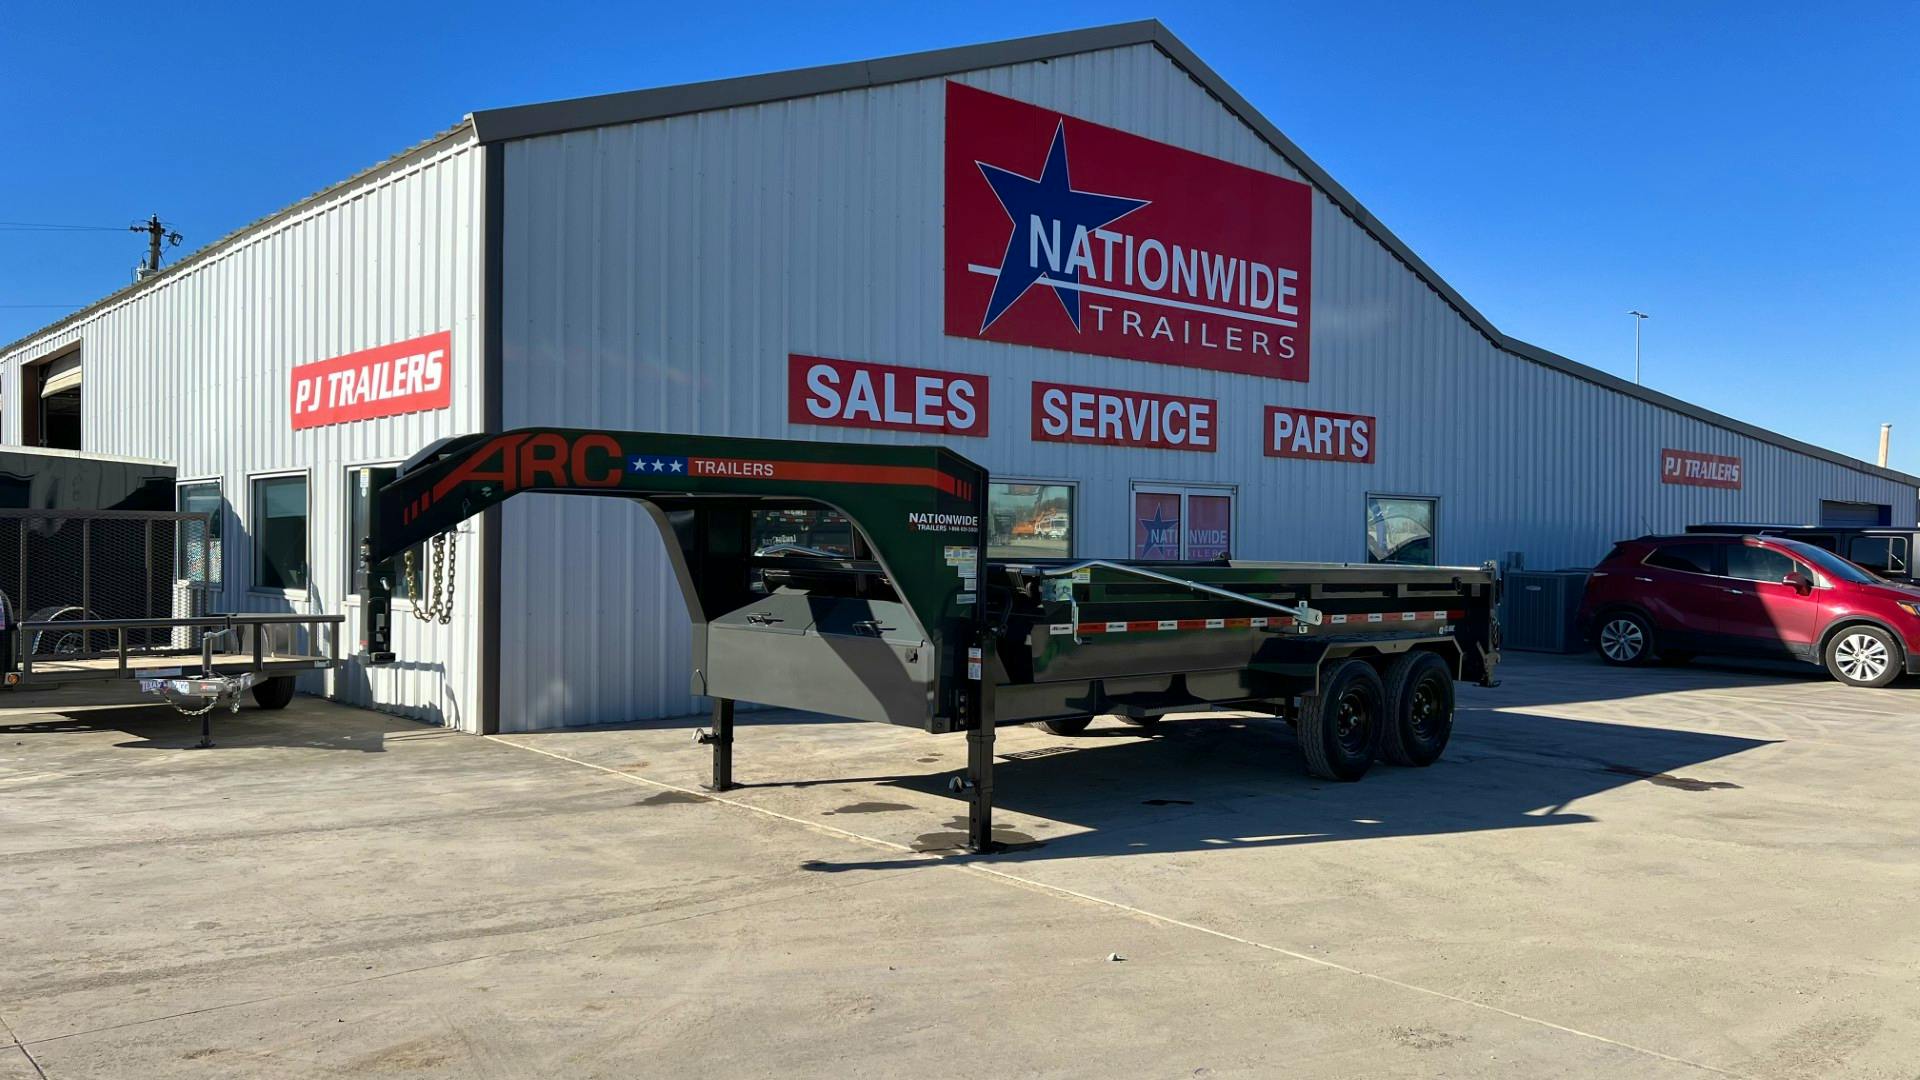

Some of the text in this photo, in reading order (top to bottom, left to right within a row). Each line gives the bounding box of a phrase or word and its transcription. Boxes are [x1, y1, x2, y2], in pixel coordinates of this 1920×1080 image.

[1030, 214, 1298, 315] NATIONWIDE
[1089, 304, 1295, 359] TRAILERS
[295, 350, 444, 414] PJ TRAILERS
[806, 364, 976, 429] SALES
[1041, 388, 1210, 445] SERVICE
[1273, 412, 1370, 457] PARTS
[432, 431, 774, 503] ARC TRAILERS
[1665, 457, 1740, 482] PJ TRAILERS
[908, 513, 978, 526] NATIONWIDE
[917, 524, 947, 532] TRAILERS
[1151, 529, 1227, 544] NATINWIDE
